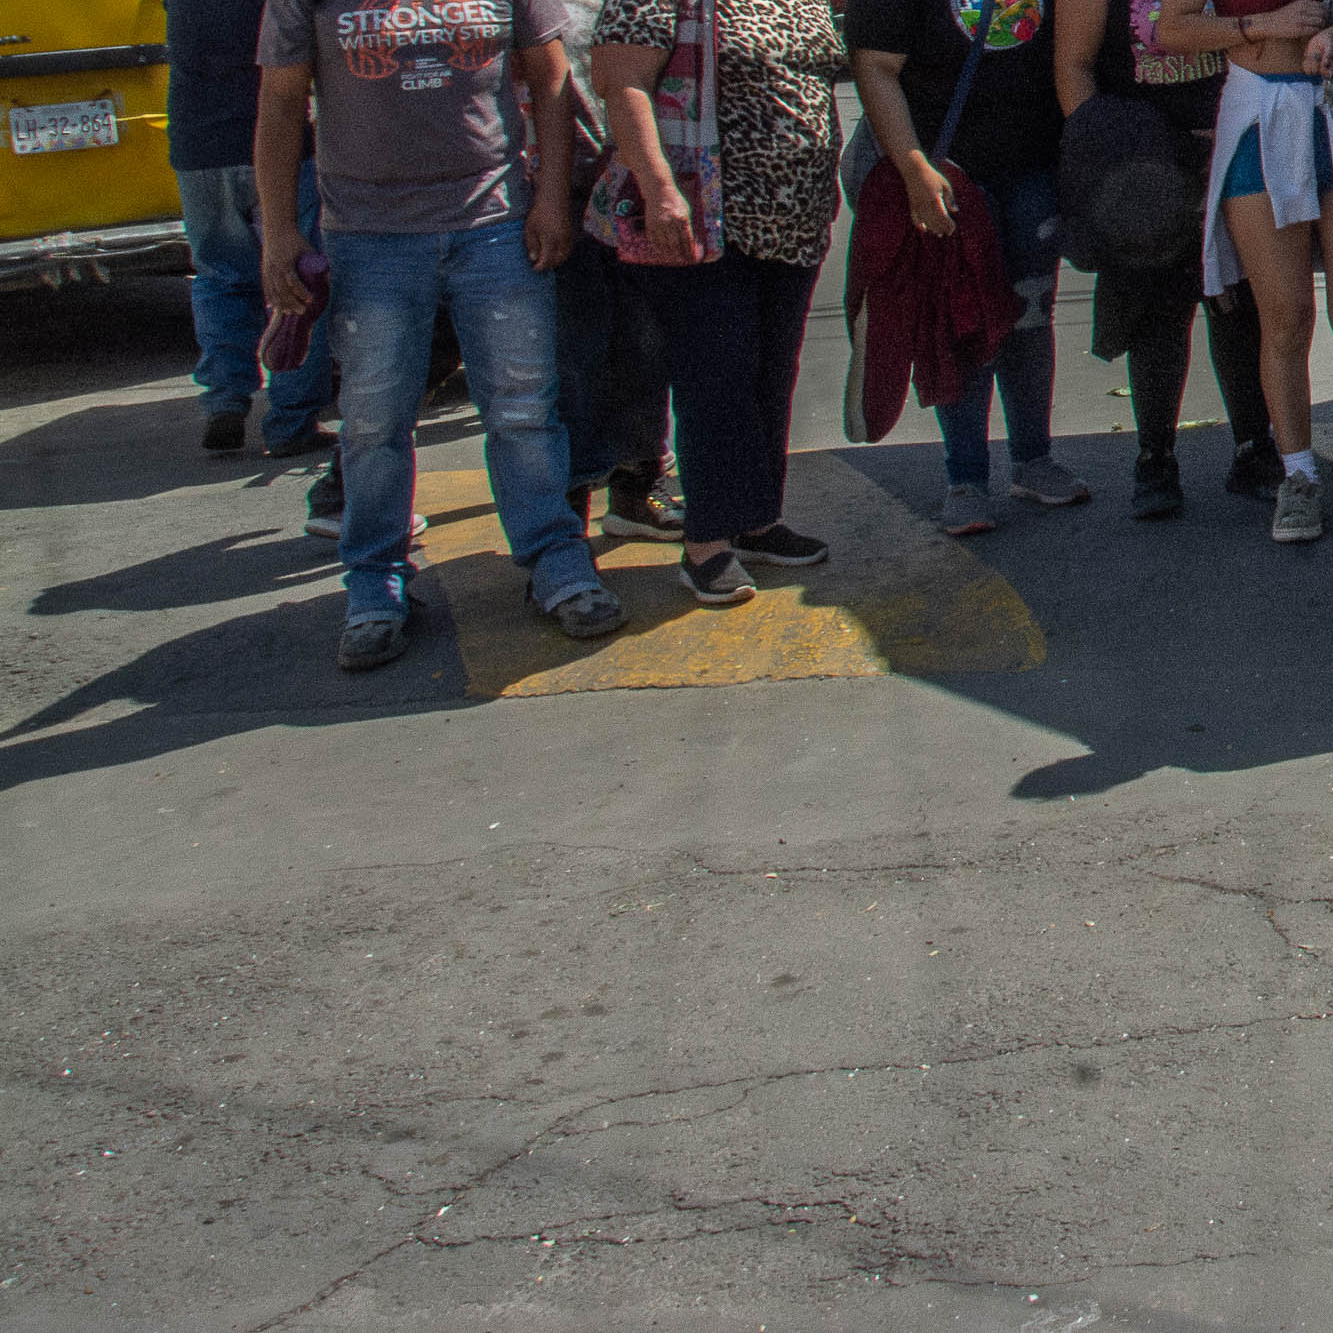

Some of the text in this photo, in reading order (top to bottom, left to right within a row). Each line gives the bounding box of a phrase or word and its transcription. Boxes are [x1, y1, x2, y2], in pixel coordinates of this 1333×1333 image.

[337, 1, 503, 34] STRONGER
[338, 24, 501, 51] WITH EVERY STEP
